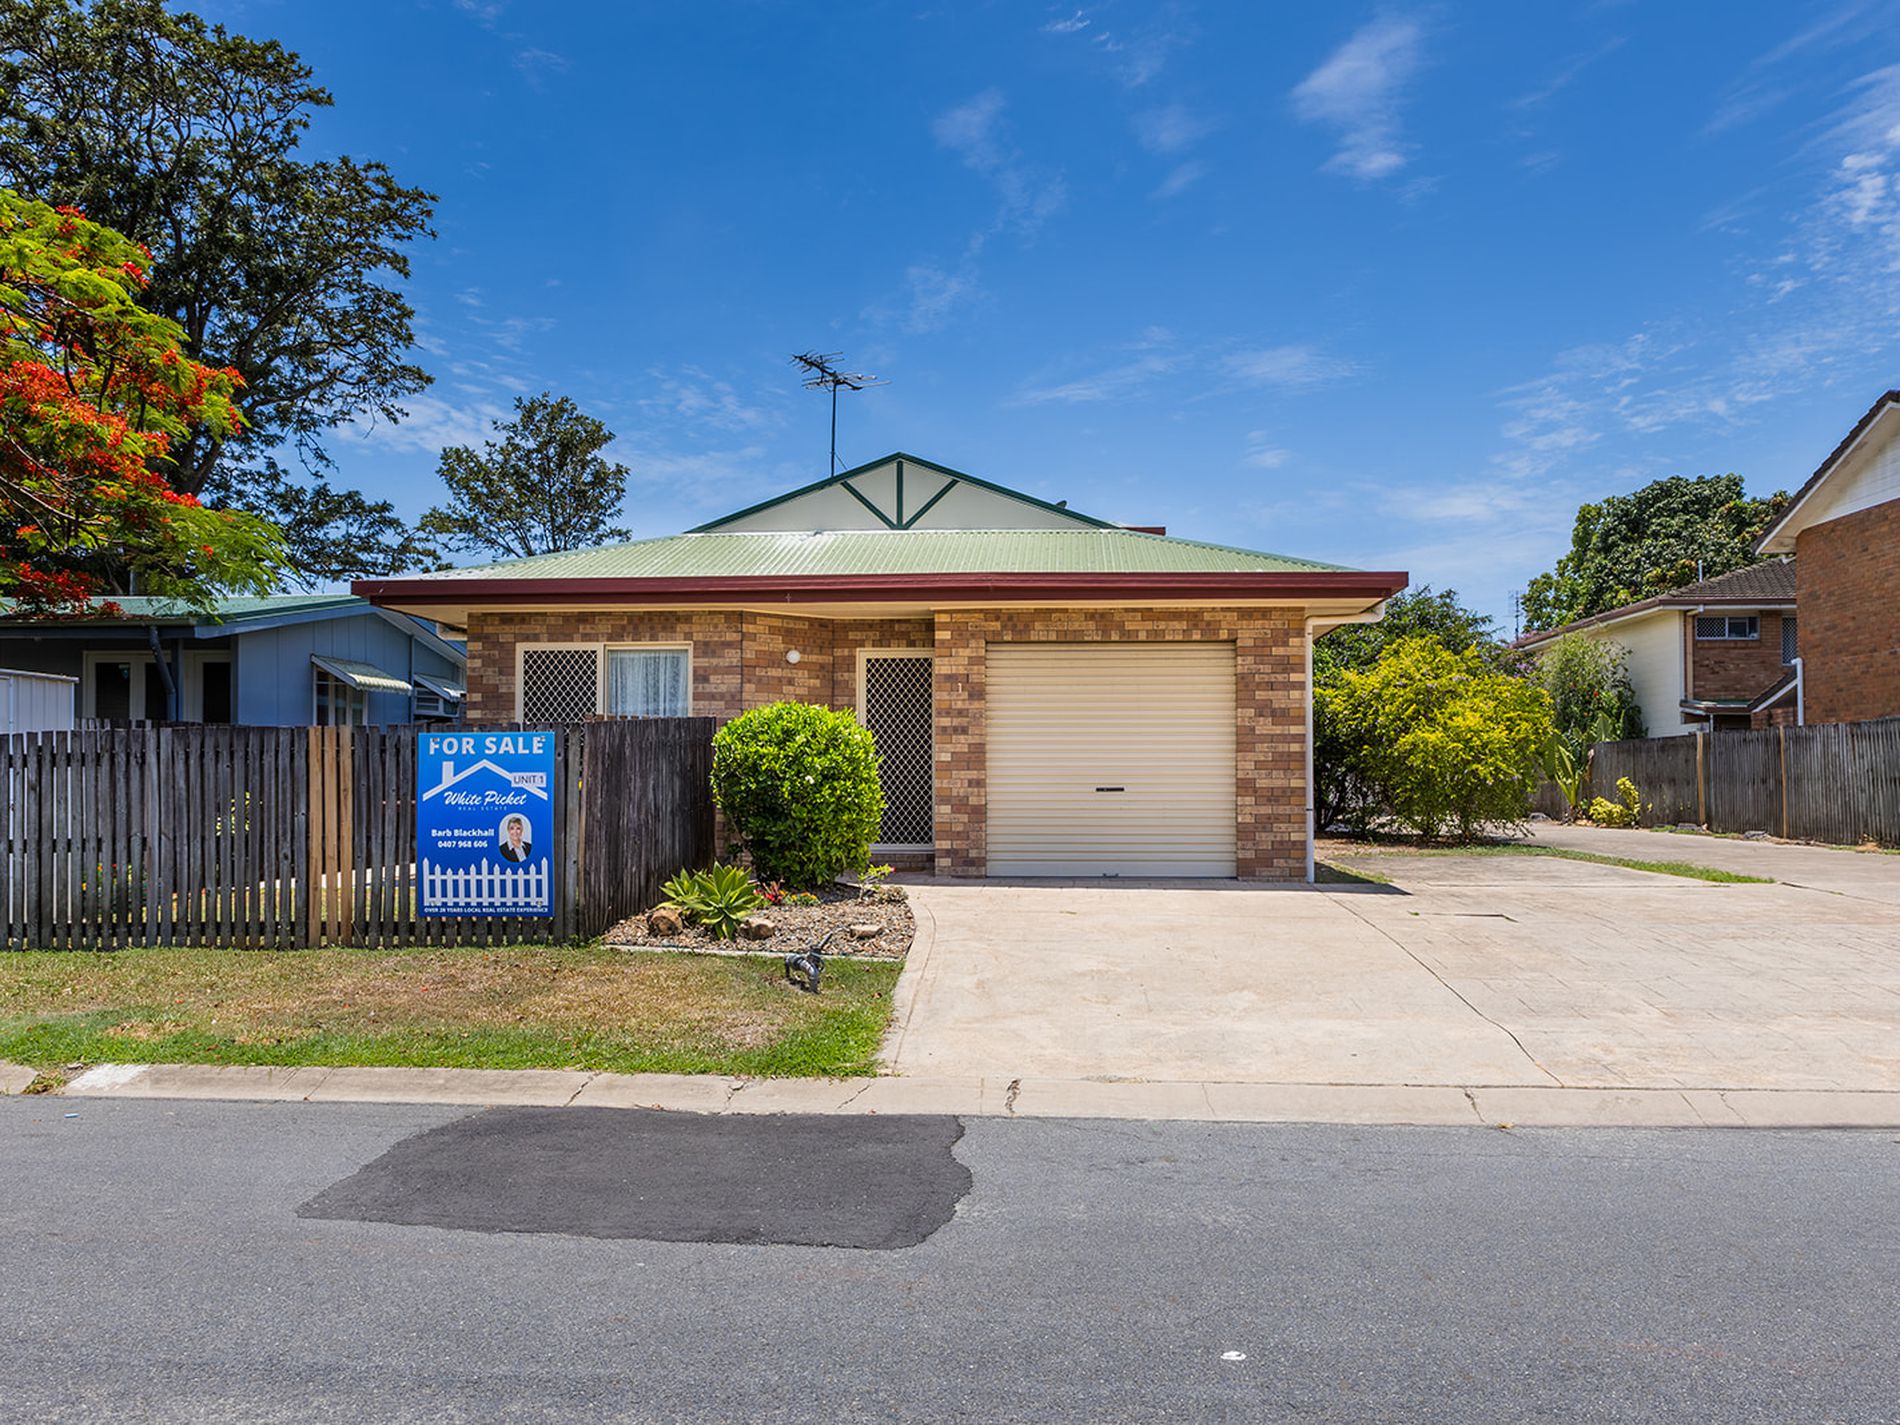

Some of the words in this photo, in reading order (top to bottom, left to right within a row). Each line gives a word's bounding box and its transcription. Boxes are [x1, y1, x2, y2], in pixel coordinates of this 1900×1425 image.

[429, 737, 476, 755] FOR
[484, 736, 544, 754] SALE
[513, 775, 537, 784] UNIT
[540, 775, 544, 784] 1
[443, 790, 482, 805] White
[484, 790, 527, 806] Picket
[431, 828, 452, 837] Barb
[454, 828, 494, 837] Blackhall
